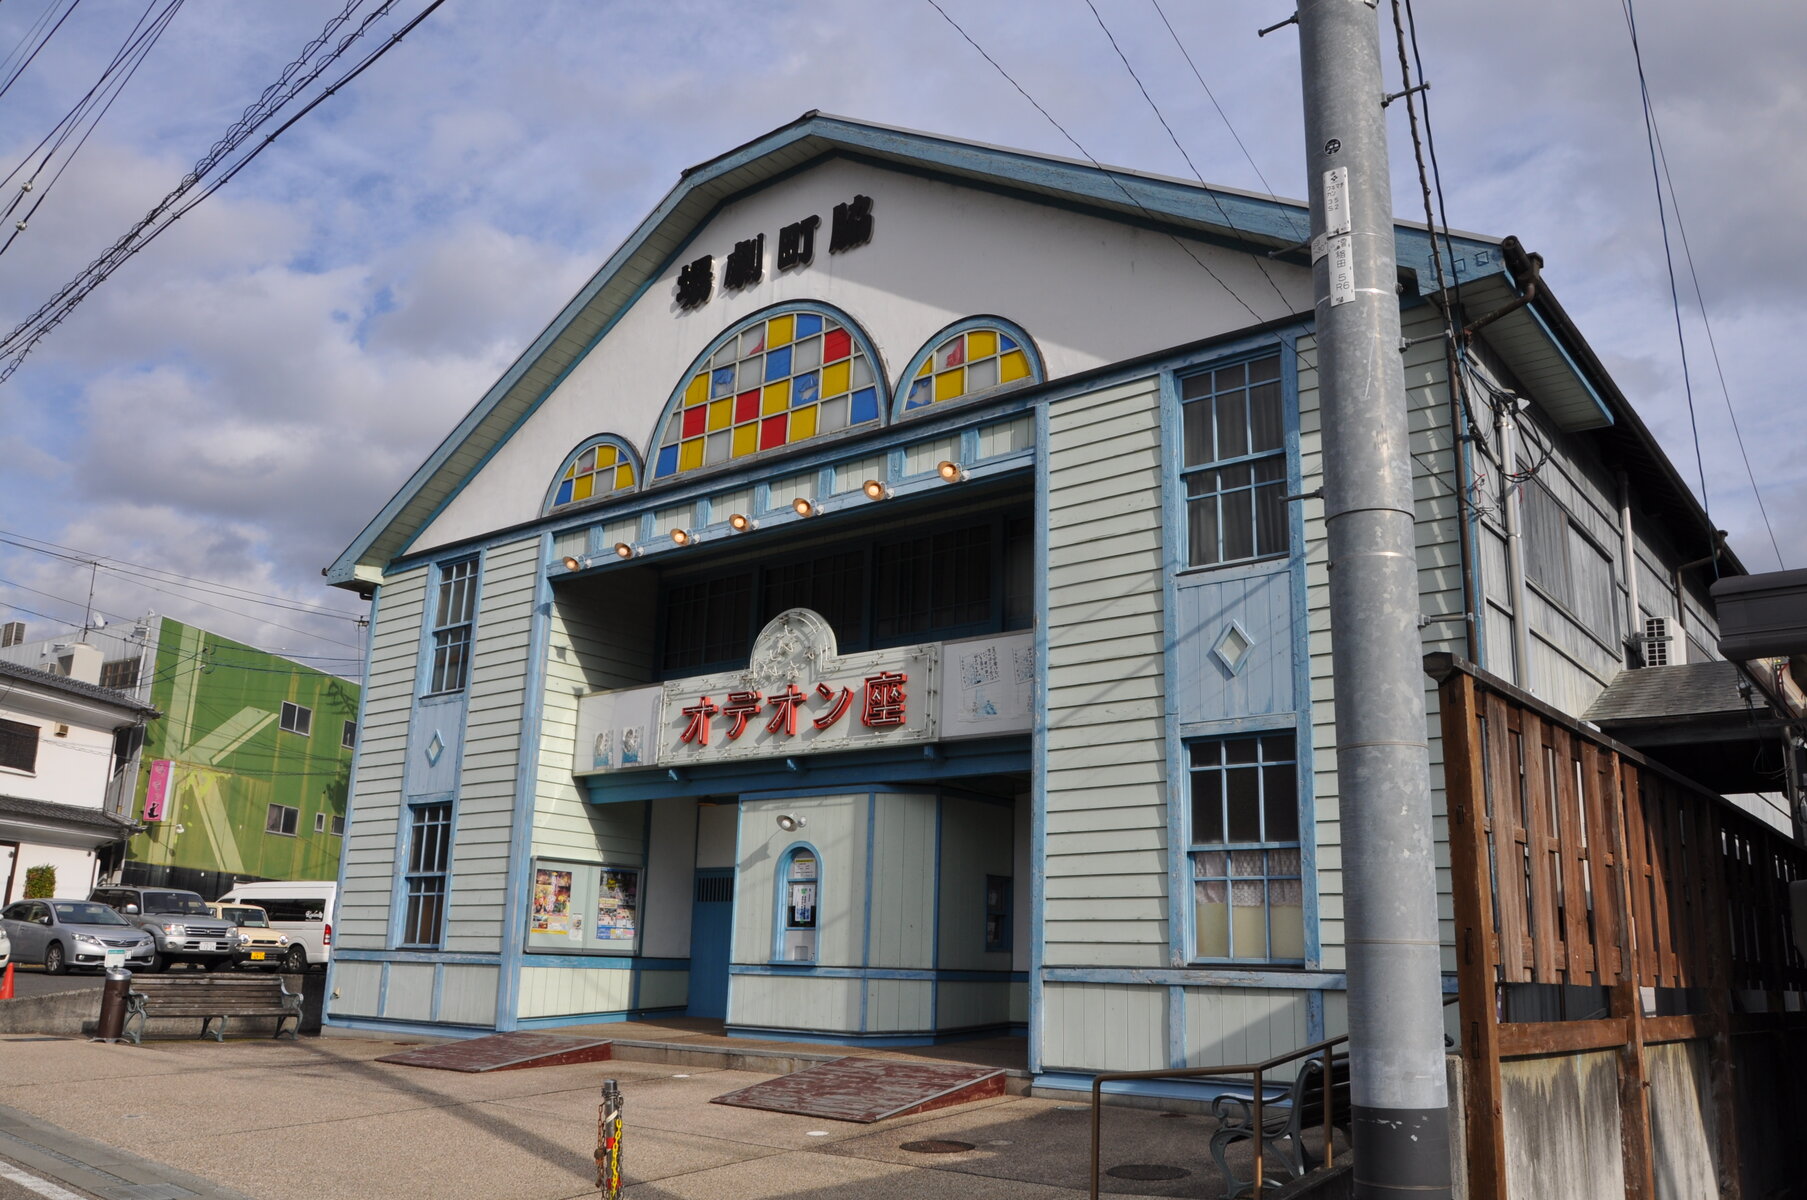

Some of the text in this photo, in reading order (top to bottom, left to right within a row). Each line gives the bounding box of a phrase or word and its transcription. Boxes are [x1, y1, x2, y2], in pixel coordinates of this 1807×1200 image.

[1338, 273, 1346, 282] 5
[1335, 281, 1350, 291] R6
[680, 671, 908, 746] オデオン座
